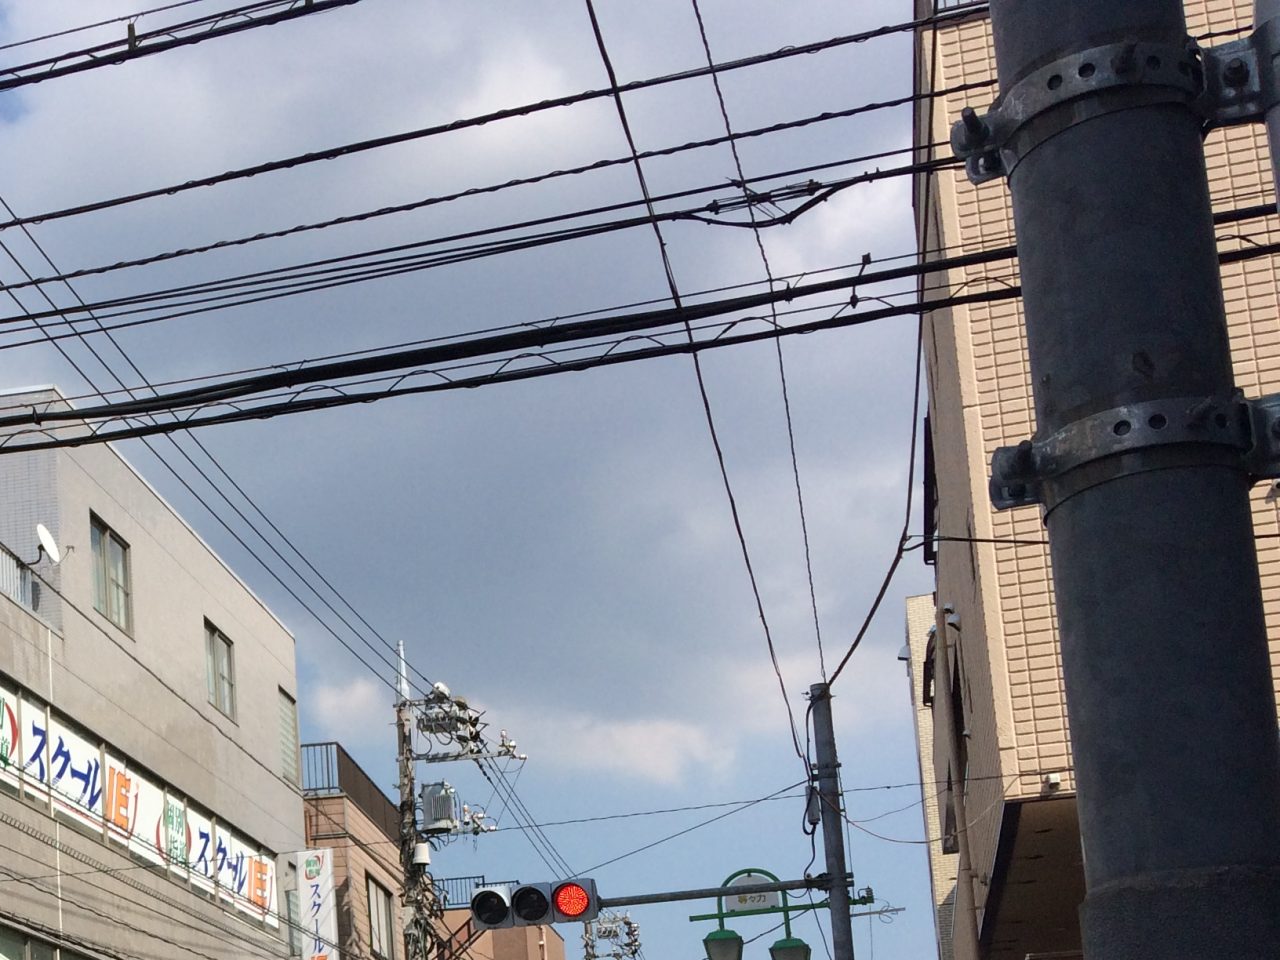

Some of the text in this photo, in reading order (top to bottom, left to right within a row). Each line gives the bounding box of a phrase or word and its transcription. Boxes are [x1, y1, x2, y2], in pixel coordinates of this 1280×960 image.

[25, 720, 101, 810] スクール
[193, 826, 247, 893] スクール
[310, 883, 324, 953] スクール
